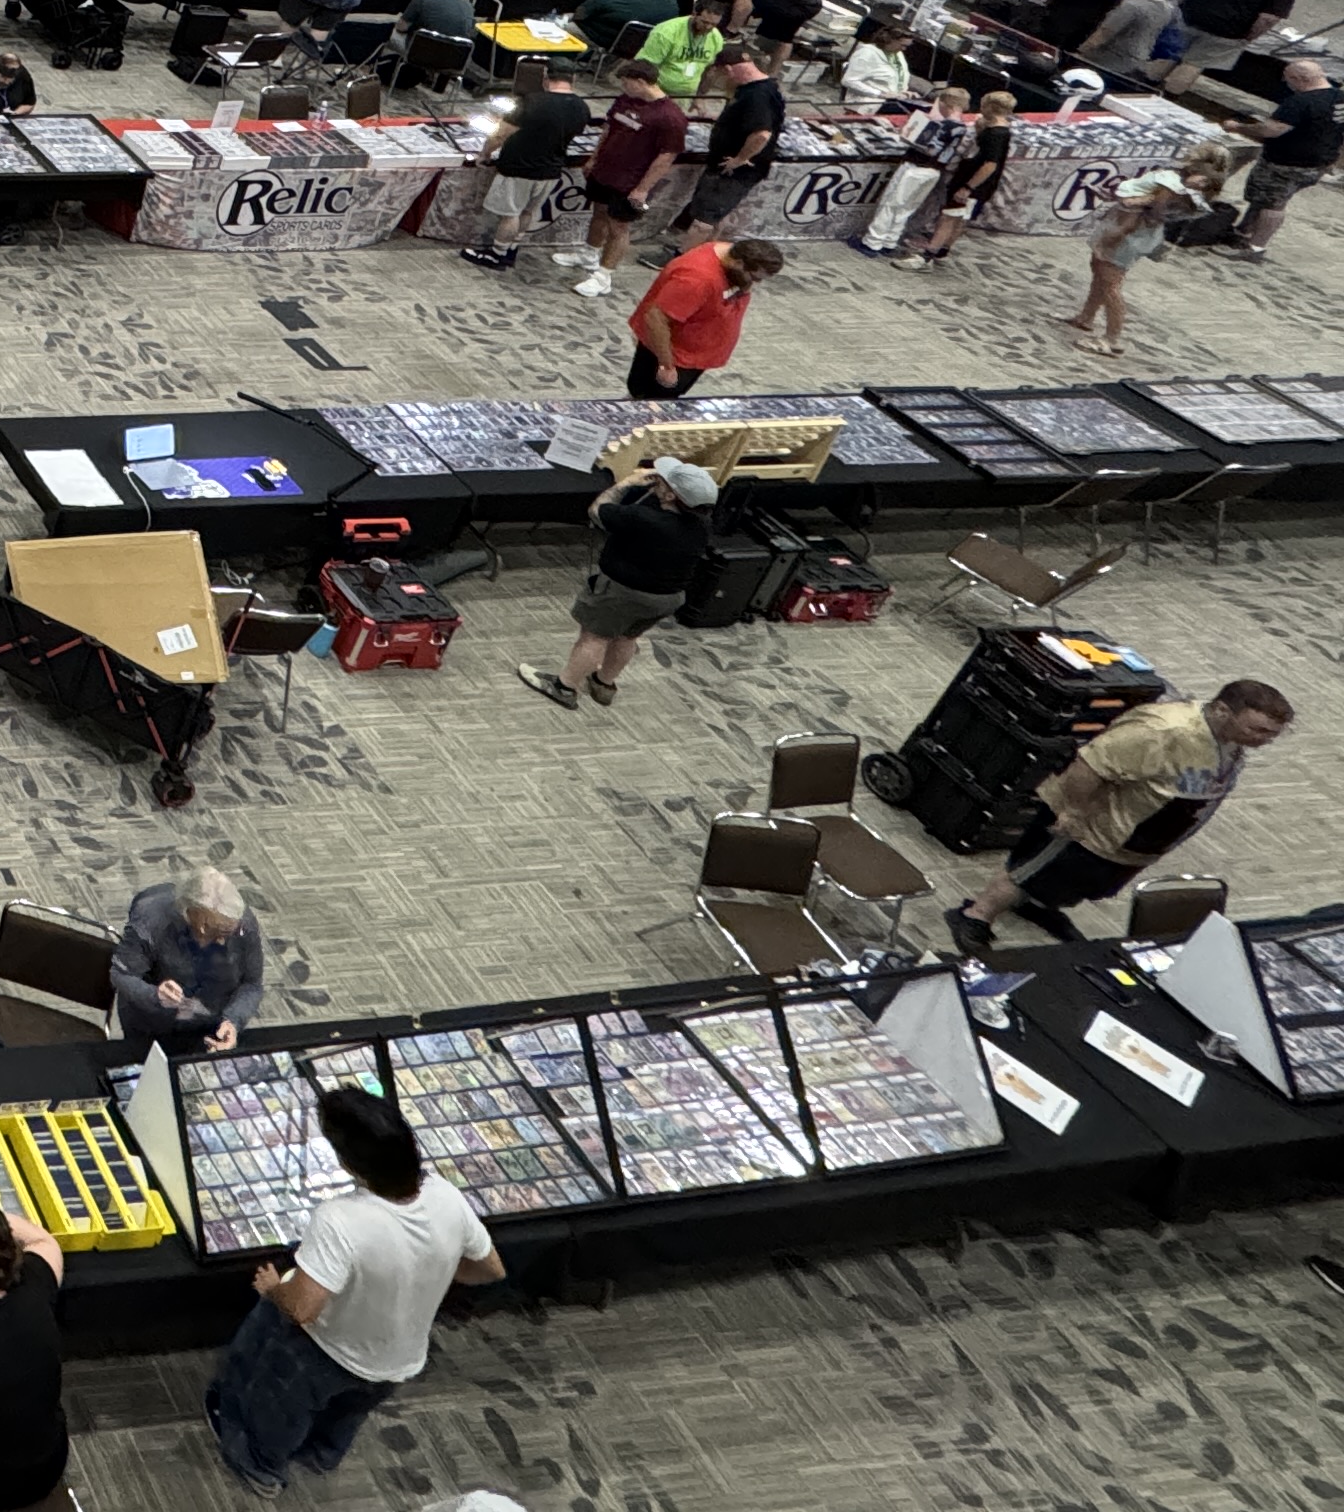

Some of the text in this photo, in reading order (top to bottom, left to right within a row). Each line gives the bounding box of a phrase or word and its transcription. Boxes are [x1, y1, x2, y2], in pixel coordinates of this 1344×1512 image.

[222, 177, 353, 227] Relic
[787, 169, 892, 215] Reli
[268, 219, 343, 233] SPORTS CARDS
